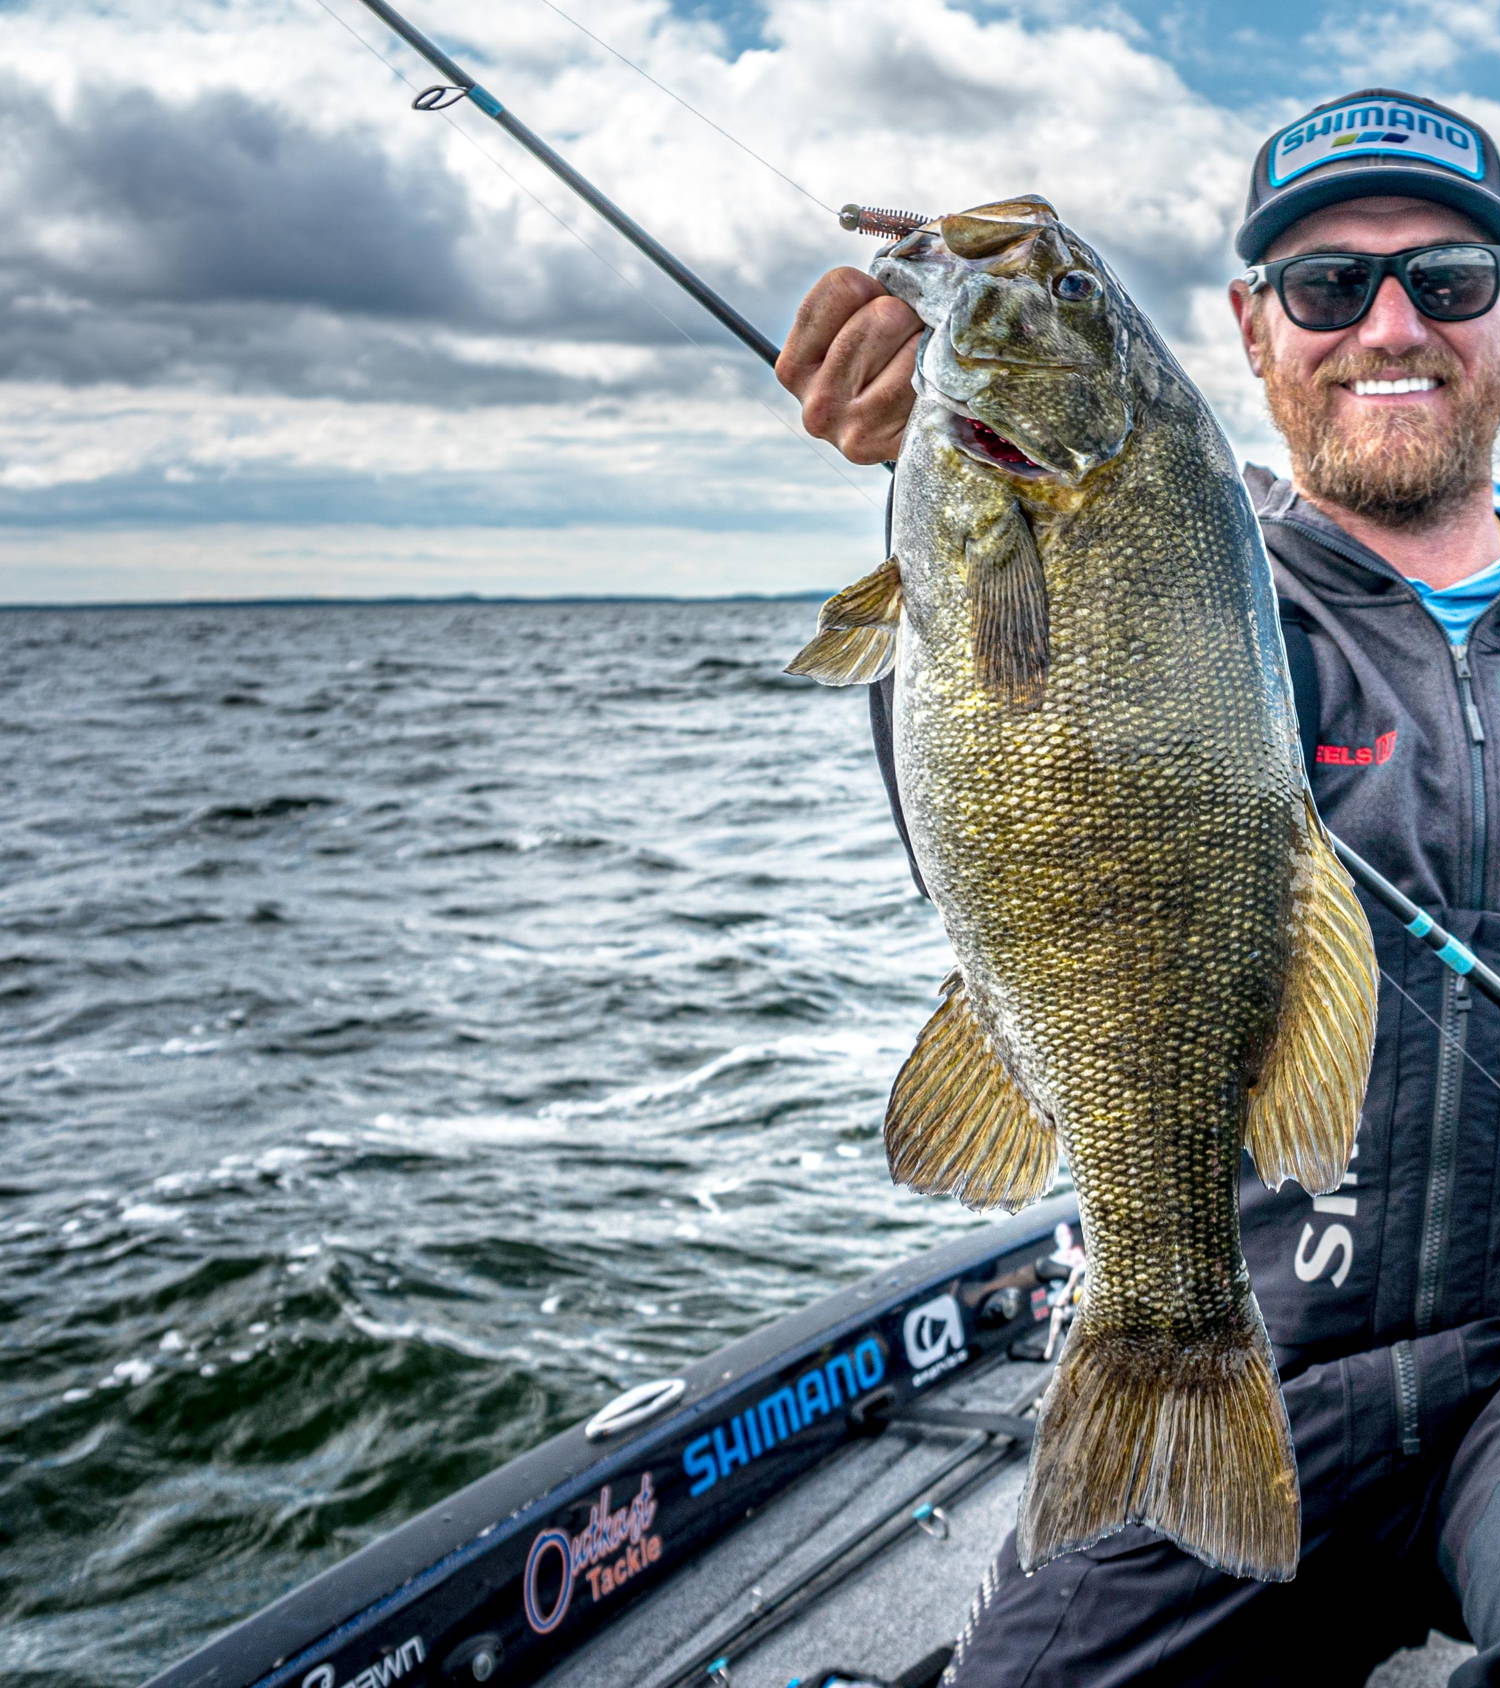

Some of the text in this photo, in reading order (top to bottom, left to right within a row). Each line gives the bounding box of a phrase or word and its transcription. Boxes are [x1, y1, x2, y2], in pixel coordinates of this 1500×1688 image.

[1281, 106, 1469, 156] SHIMANO
[682, 1337, 885, 1498] SHIMANO
[586, 1535, 663, 1602] Tackle
